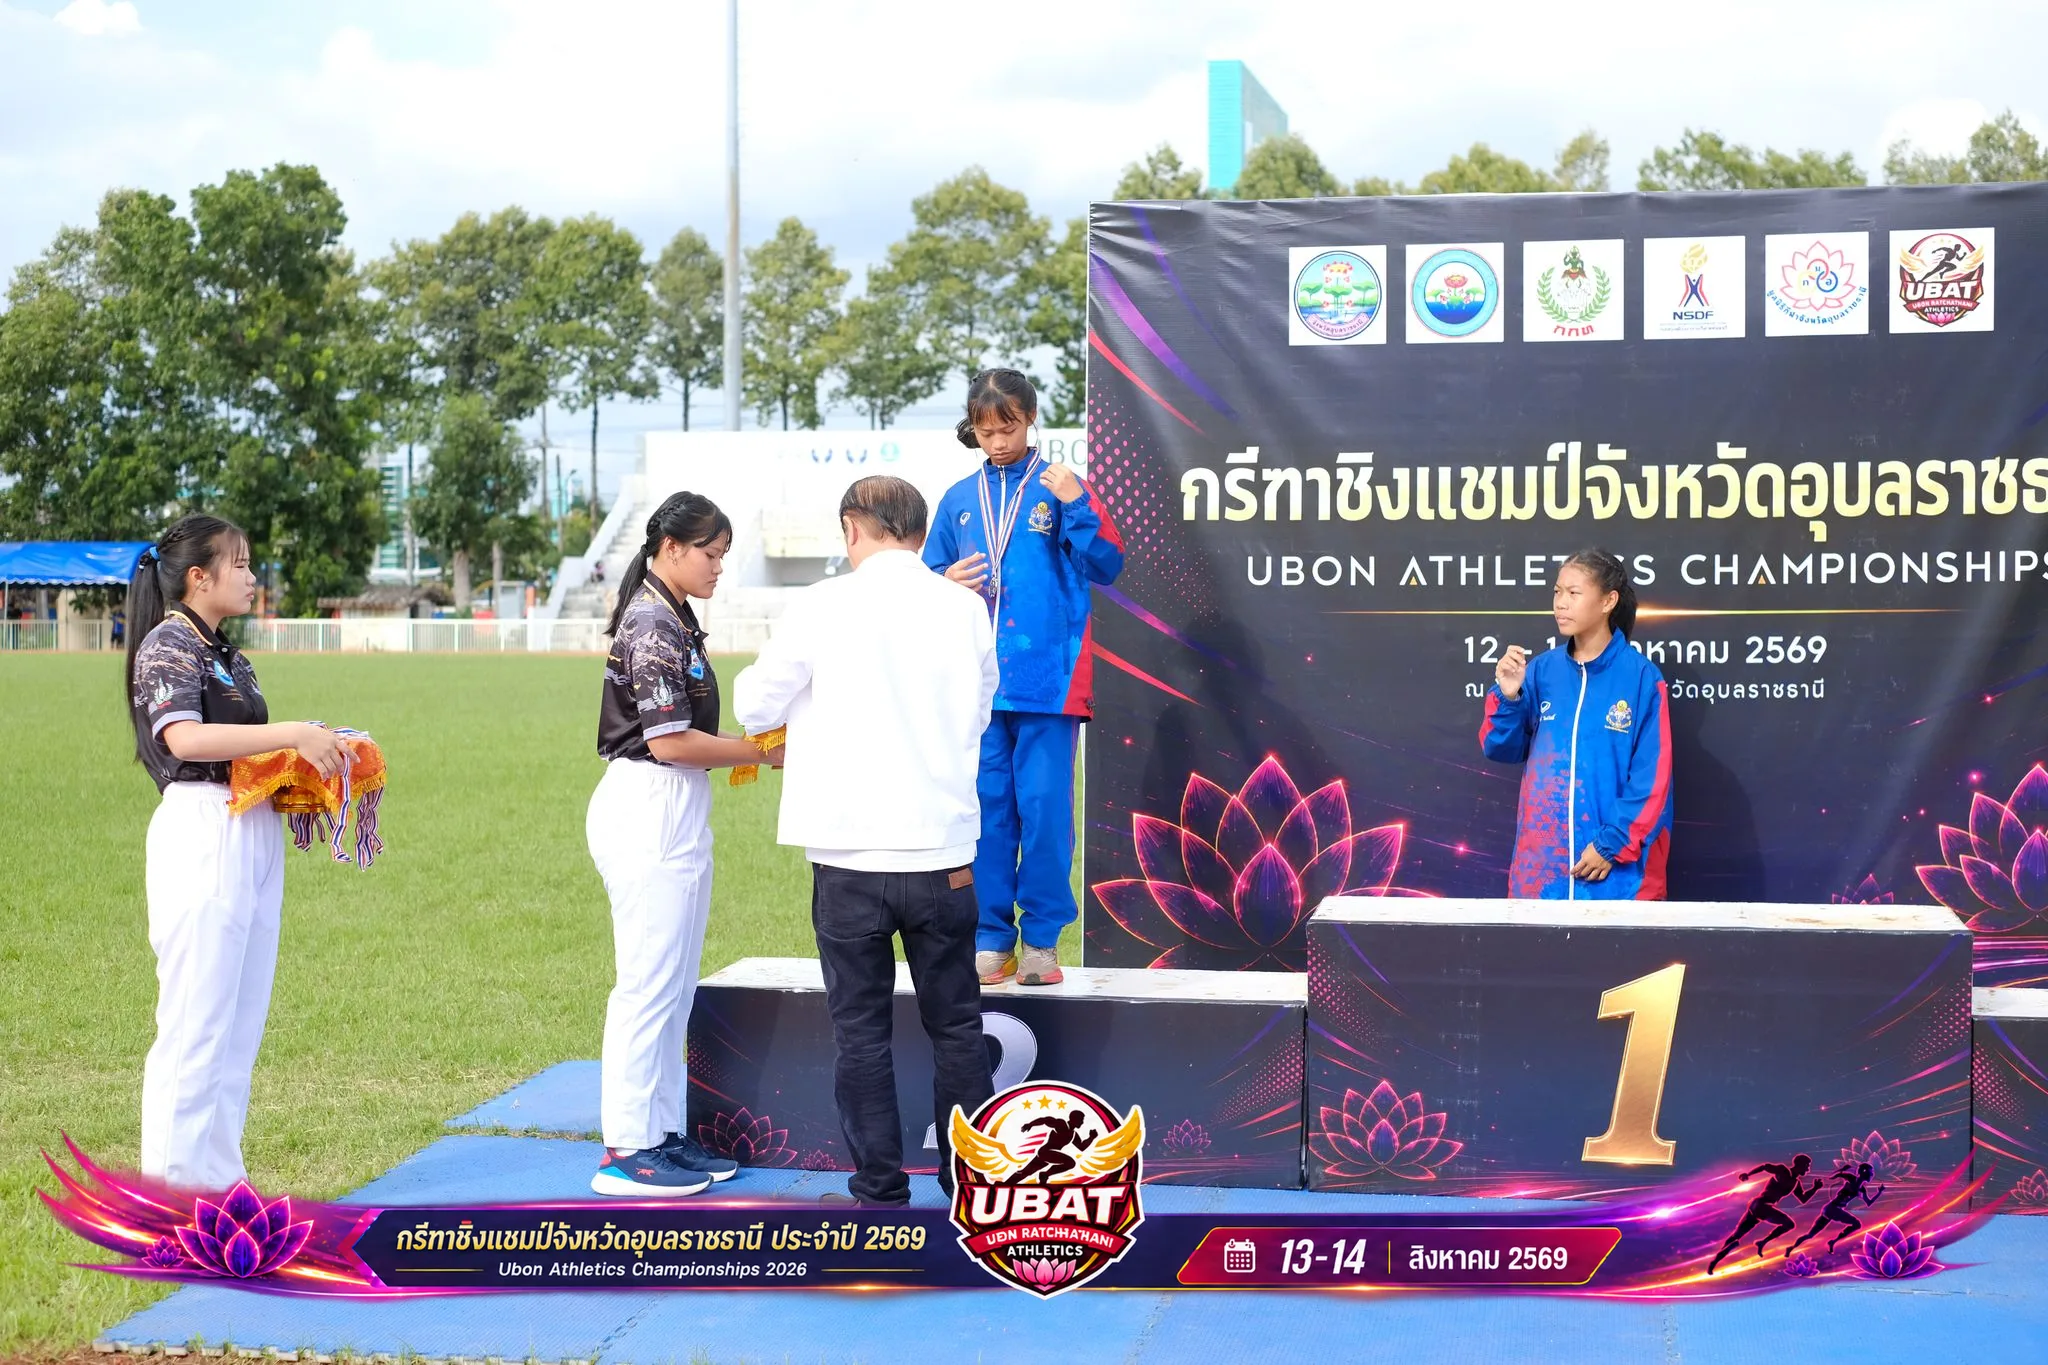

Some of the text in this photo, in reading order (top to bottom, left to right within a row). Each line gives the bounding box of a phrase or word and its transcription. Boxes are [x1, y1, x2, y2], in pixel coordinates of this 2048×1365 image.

[1905, 281, 1978, 301] UBAT
[1672, 310, 1714, 321] NSDF
[1924, 306, 1960, 314] ATHLETICS
[1247, 555, 1375, 586] UBON
[1399, 554, 1656, 586] ATHLES
[1464, 635, 1499, 664] 12
[1745, 635, 1828, 664] 2569
[1581, 961, 1687, 1168] 1
